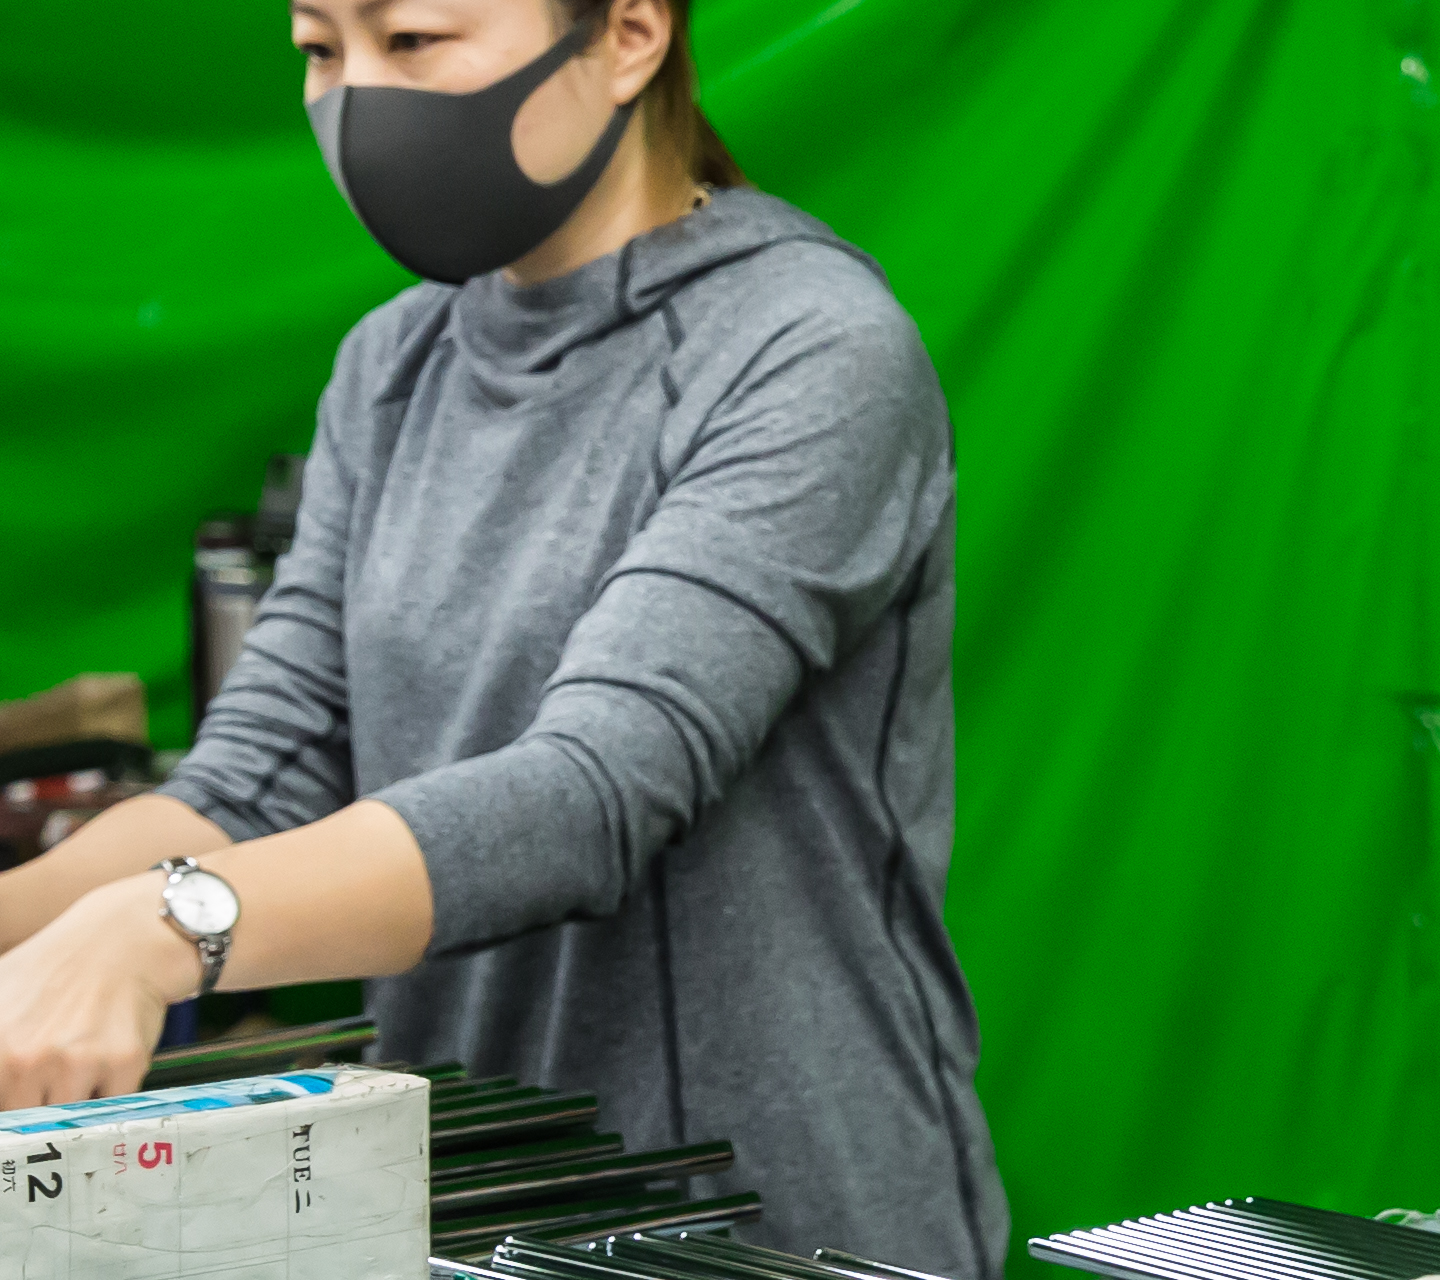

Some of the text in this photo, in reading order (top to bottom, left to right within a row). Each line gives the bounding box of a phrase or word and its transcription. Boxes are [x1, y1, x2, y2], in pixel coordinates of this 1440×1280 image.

[1, 1158, 17, 1194] 初六
[26, 1141, 63, 1203] 12
[137, 1141, 173, 1170] 5
[292, 1124, 312, 1183] TUE
